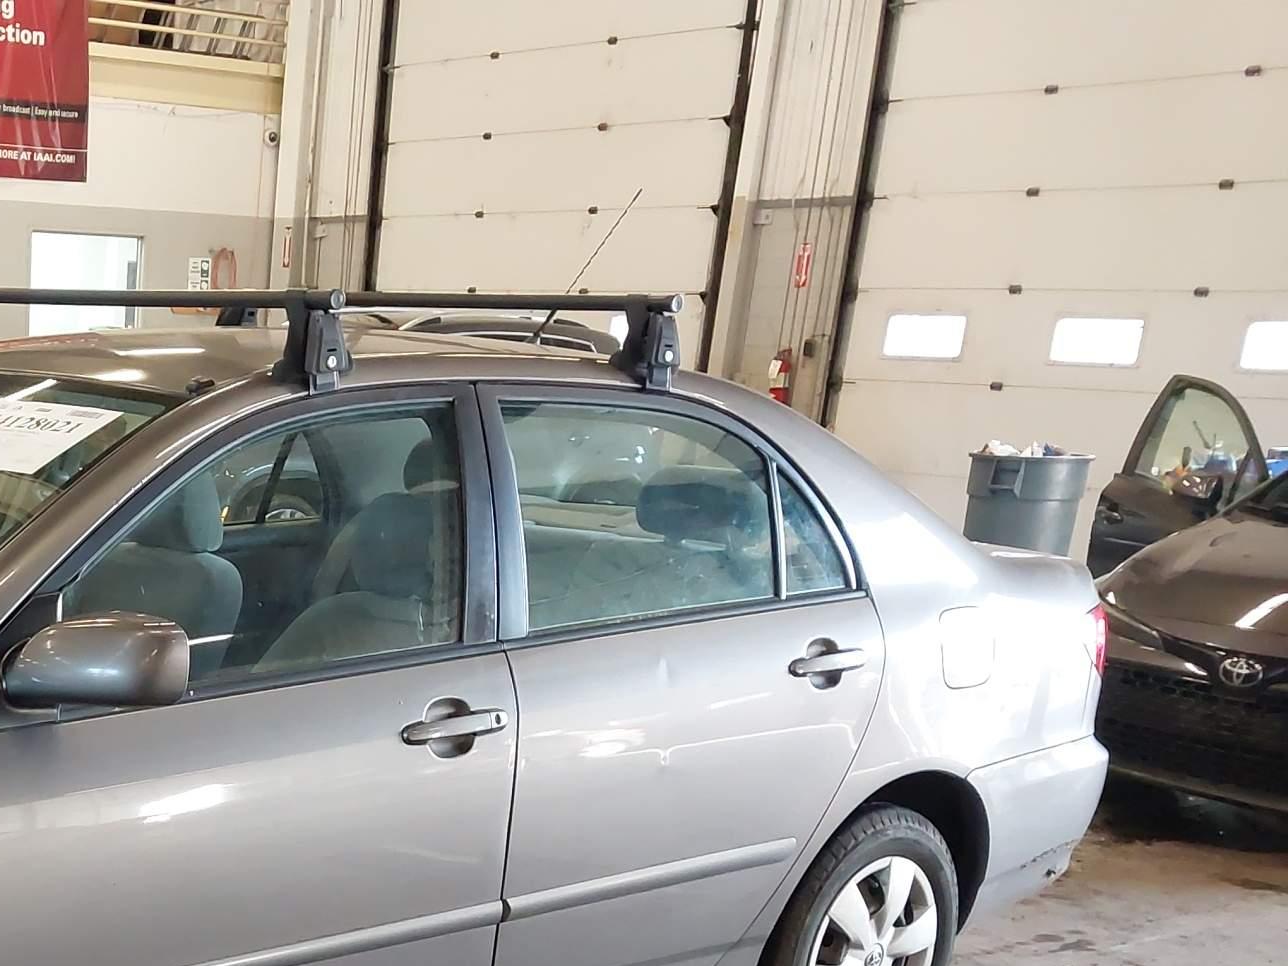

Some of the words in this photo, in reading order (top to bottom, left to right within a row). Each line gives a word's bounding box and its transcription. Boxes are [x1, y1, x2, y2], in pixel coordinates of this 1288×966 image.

[2, 103, 31, 114] broadcast
[35, 108, 47, 118] Easy
[48, 107, 60, 117] and
[19, 152, 31, 161] AT
